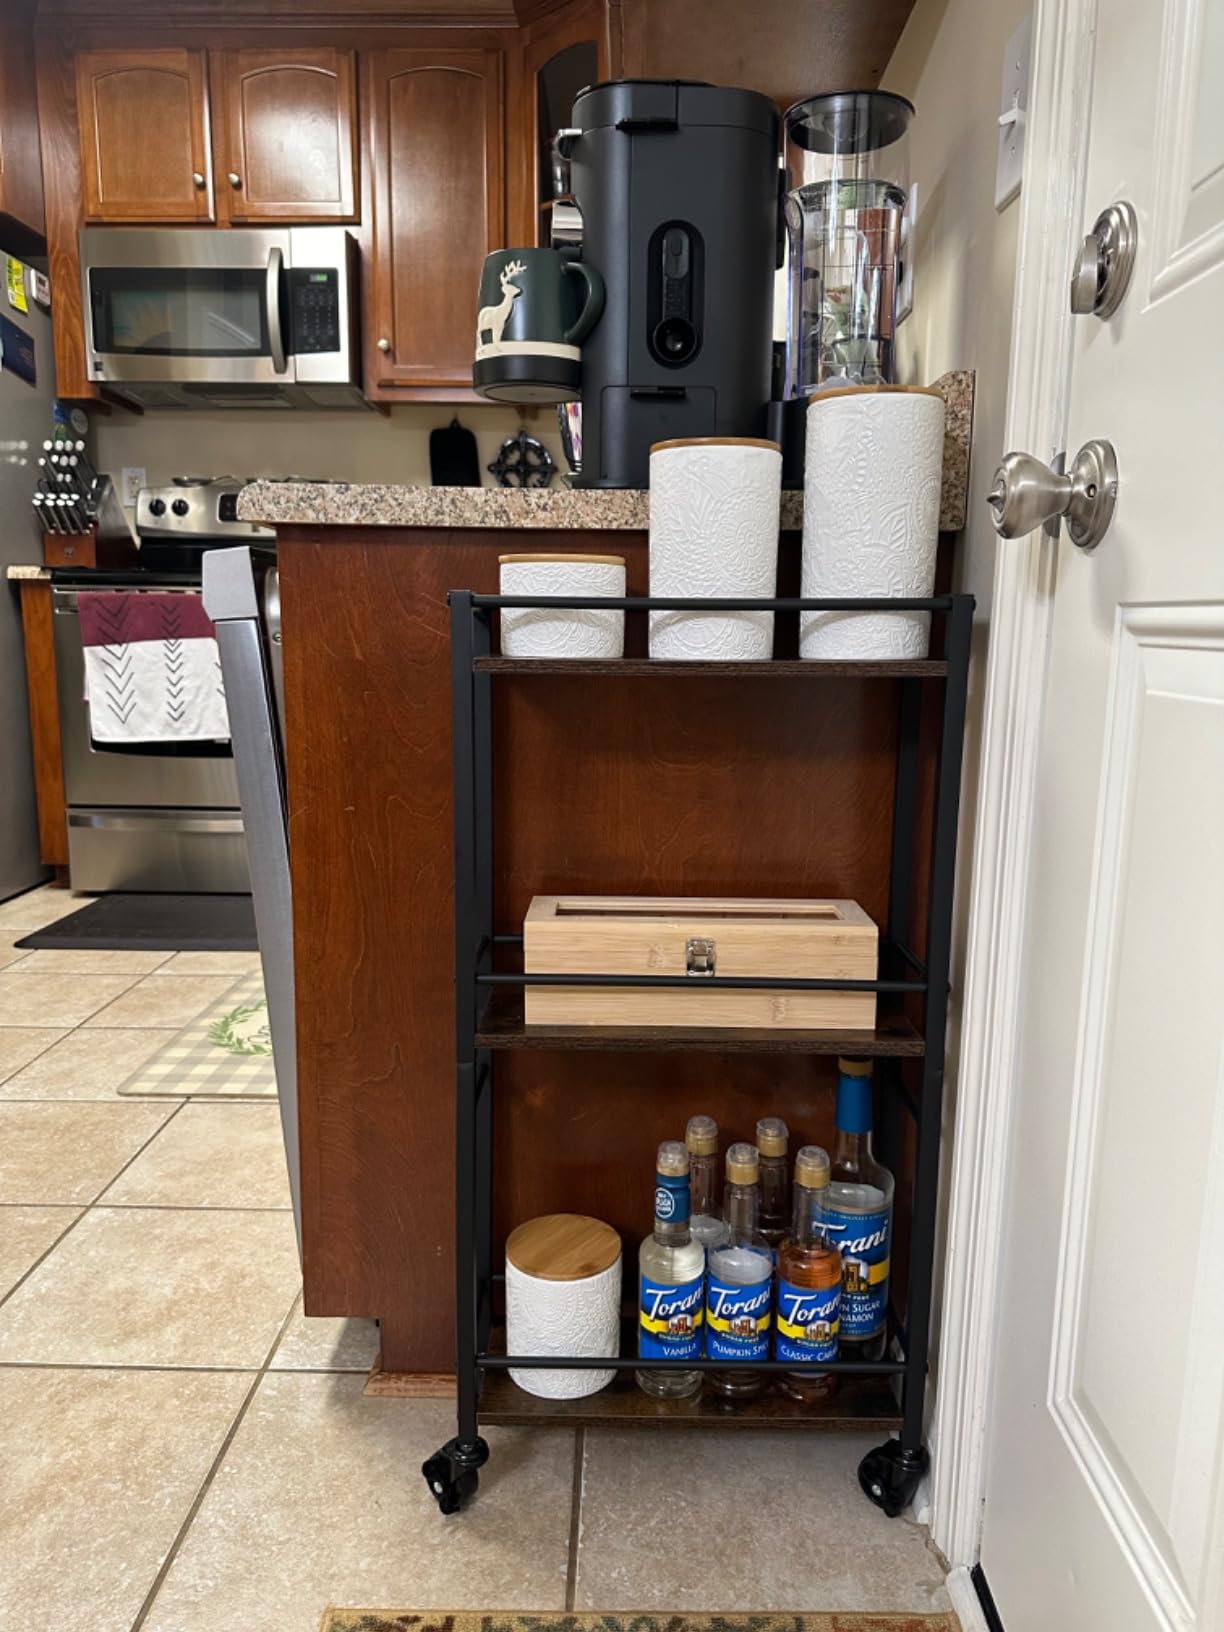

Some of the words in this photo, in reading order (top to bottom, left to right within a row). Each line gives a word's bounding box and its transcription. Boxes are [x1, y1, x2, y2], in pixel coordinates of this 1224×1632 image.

[812, 1220, 889, 1255] Trani
[784, 1292, 841, 1327] Toran
[852, 1300, 881, 1313] SUGAR
[662, 1342, 697, 1356] VANILLA
[713, 1340, 751, 1357] PUMPKIN
